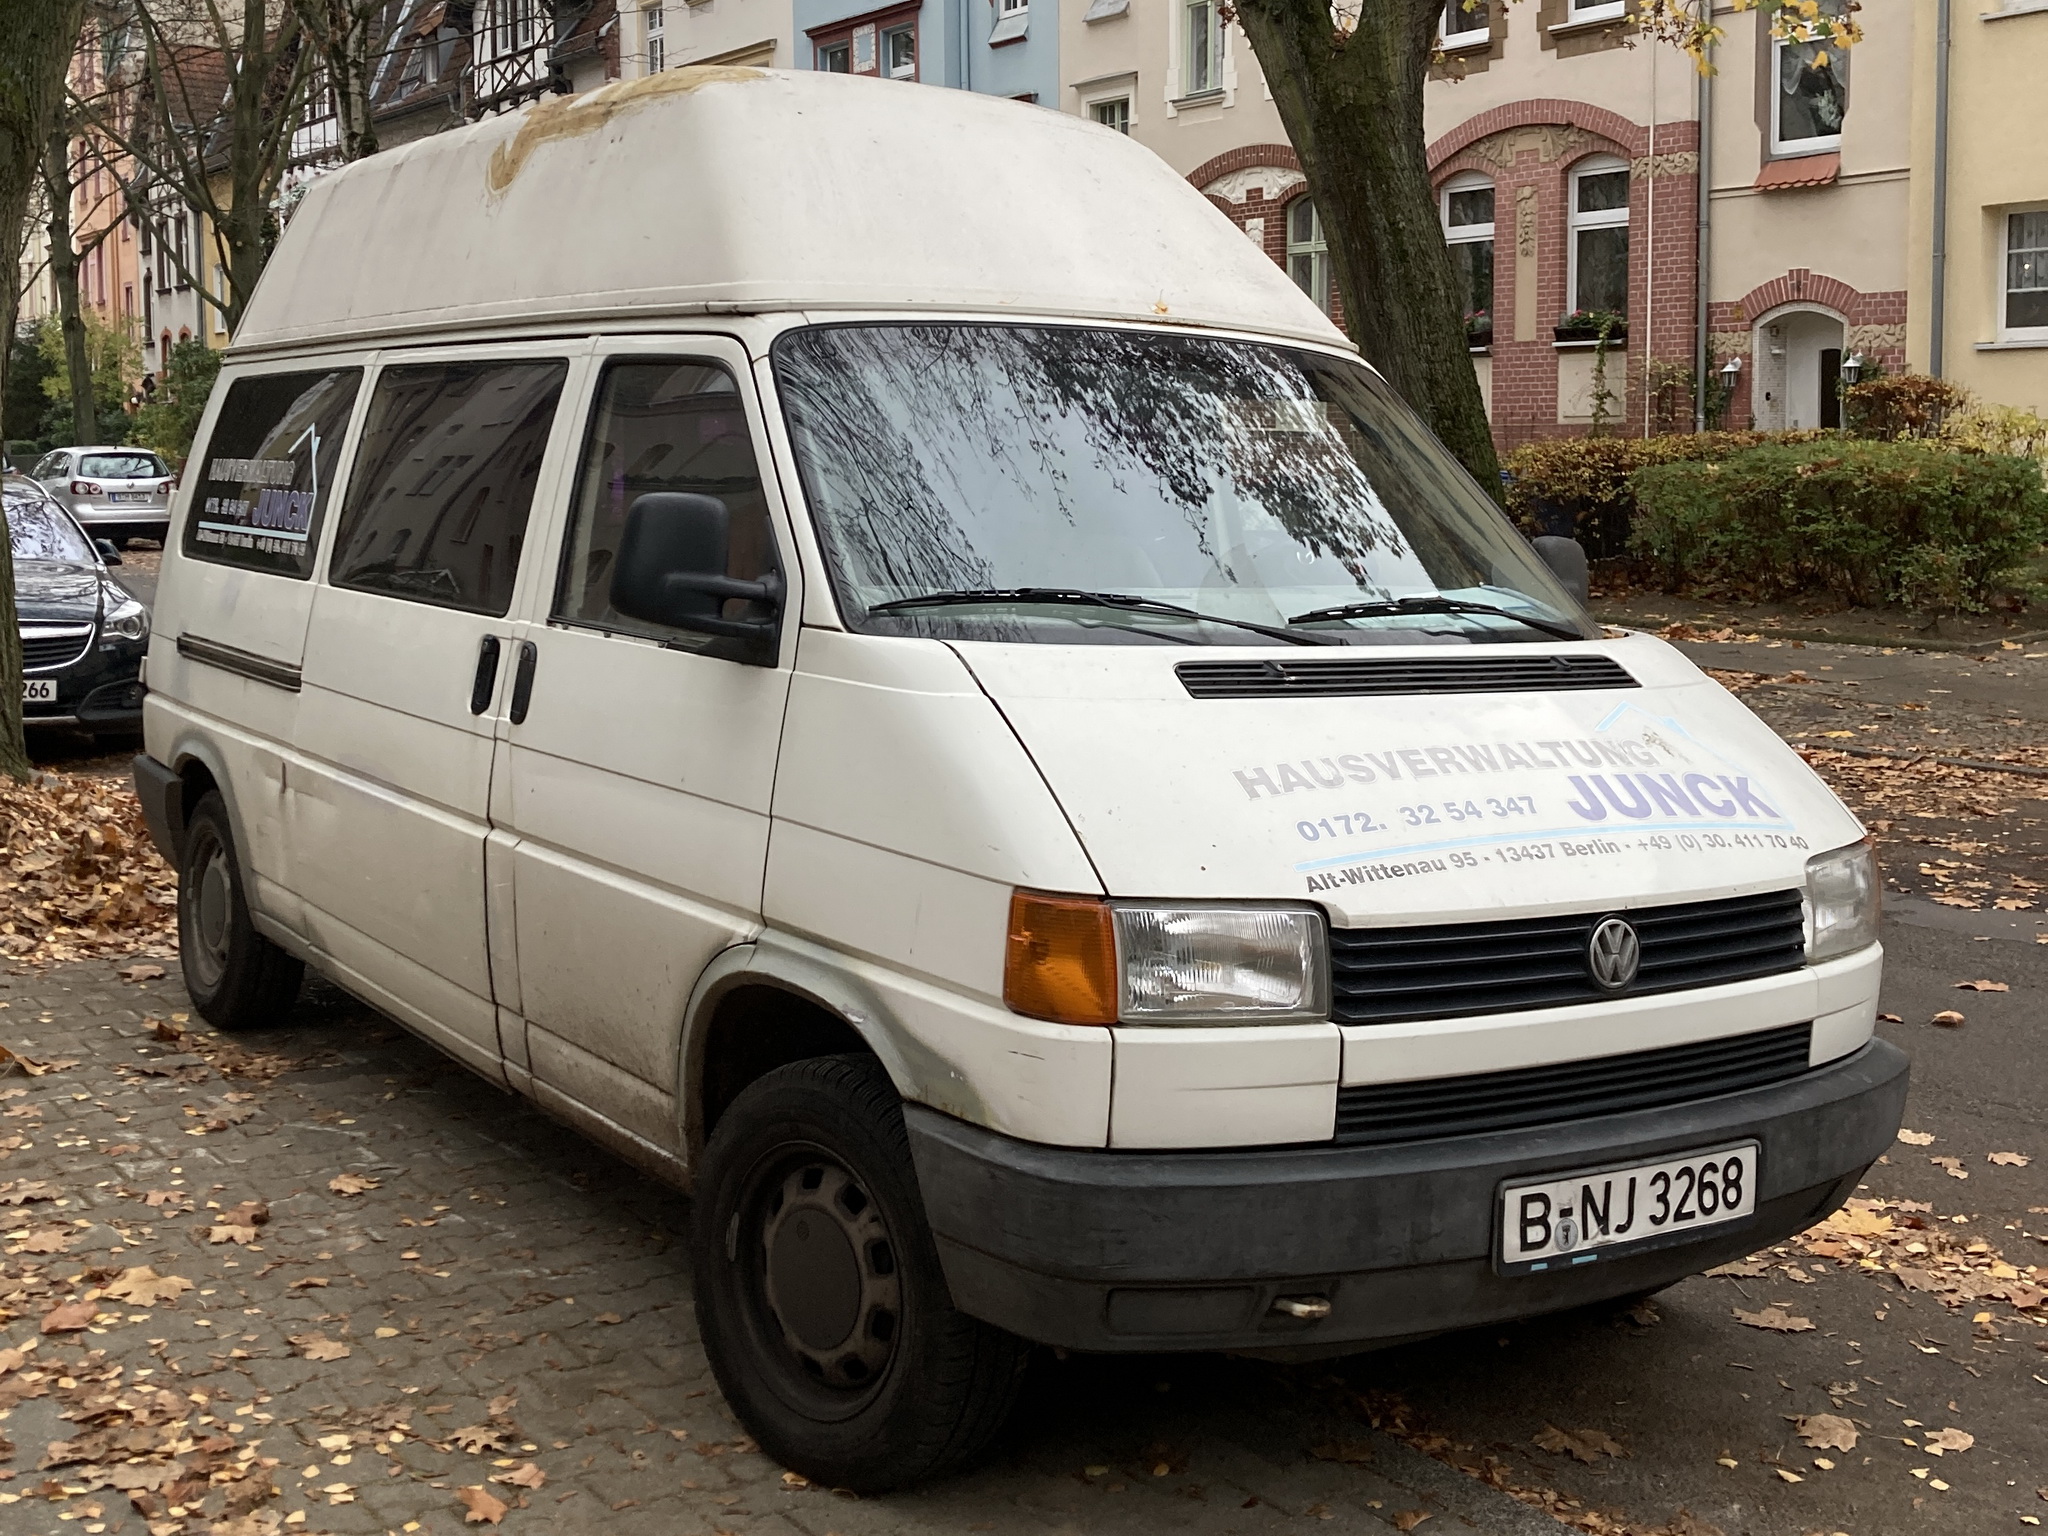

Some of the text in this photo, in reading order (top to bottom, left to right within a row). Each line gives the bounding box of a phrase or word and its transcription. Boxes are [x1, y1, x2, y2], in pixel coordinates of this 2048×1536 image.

[252, 489, 315, 531] JUNCK
[1232, 738, 1661, 799] HAUSVERWALTUNG
[1296, 794, 1537, 842] 0172. 32 54 347
[1566, 773, 1782, 821] JUNCK
[1305, 858, 1447, 893] Alt-Wittenau
[1449, 851, 1478, 869] 95
[1496, 843, 1556, 863] 13437
[1559, 838, 1622, 857] Berlin
[1637, 835, 1673, 852] +49
[1674, 833, 1703, 852] (0)
[1734, 833, 1764, 848] 411
[1763, 834, 1788, 849] 70
[1789, 835, 1810, 850] 40
[1649, 1156, 1744, 1226] 3268
